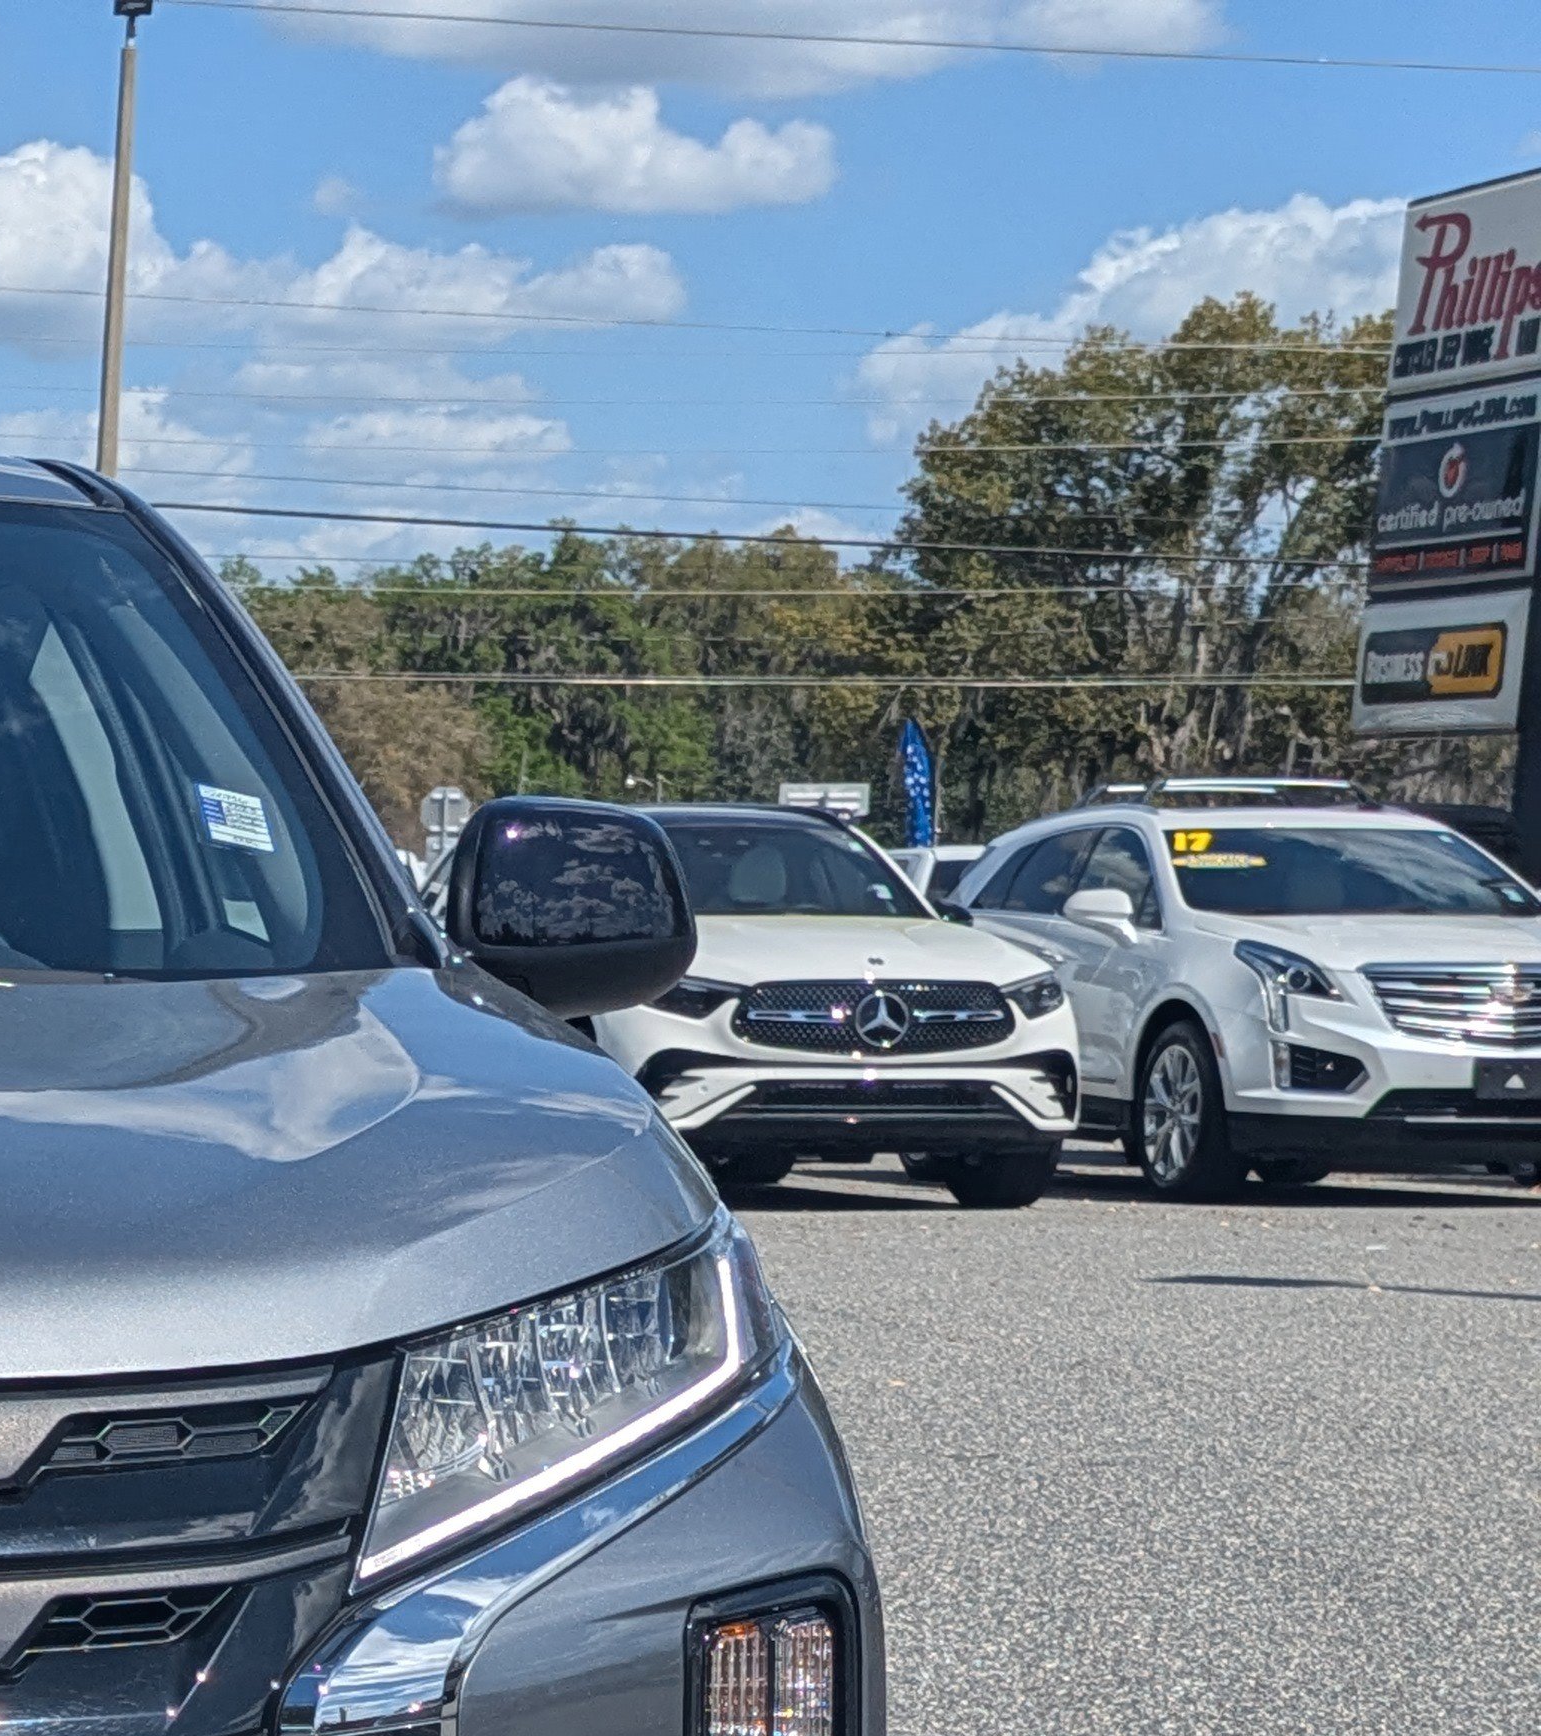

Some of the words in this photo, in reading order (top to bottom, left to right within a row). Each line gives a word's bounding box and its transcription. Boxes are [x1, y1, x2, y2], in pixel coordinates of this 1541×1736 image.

[1377, 500, 1439, 533] certified
[1443, 487, 1526, 533] pre-owned
[1173, 831, 1214, 852] 17
